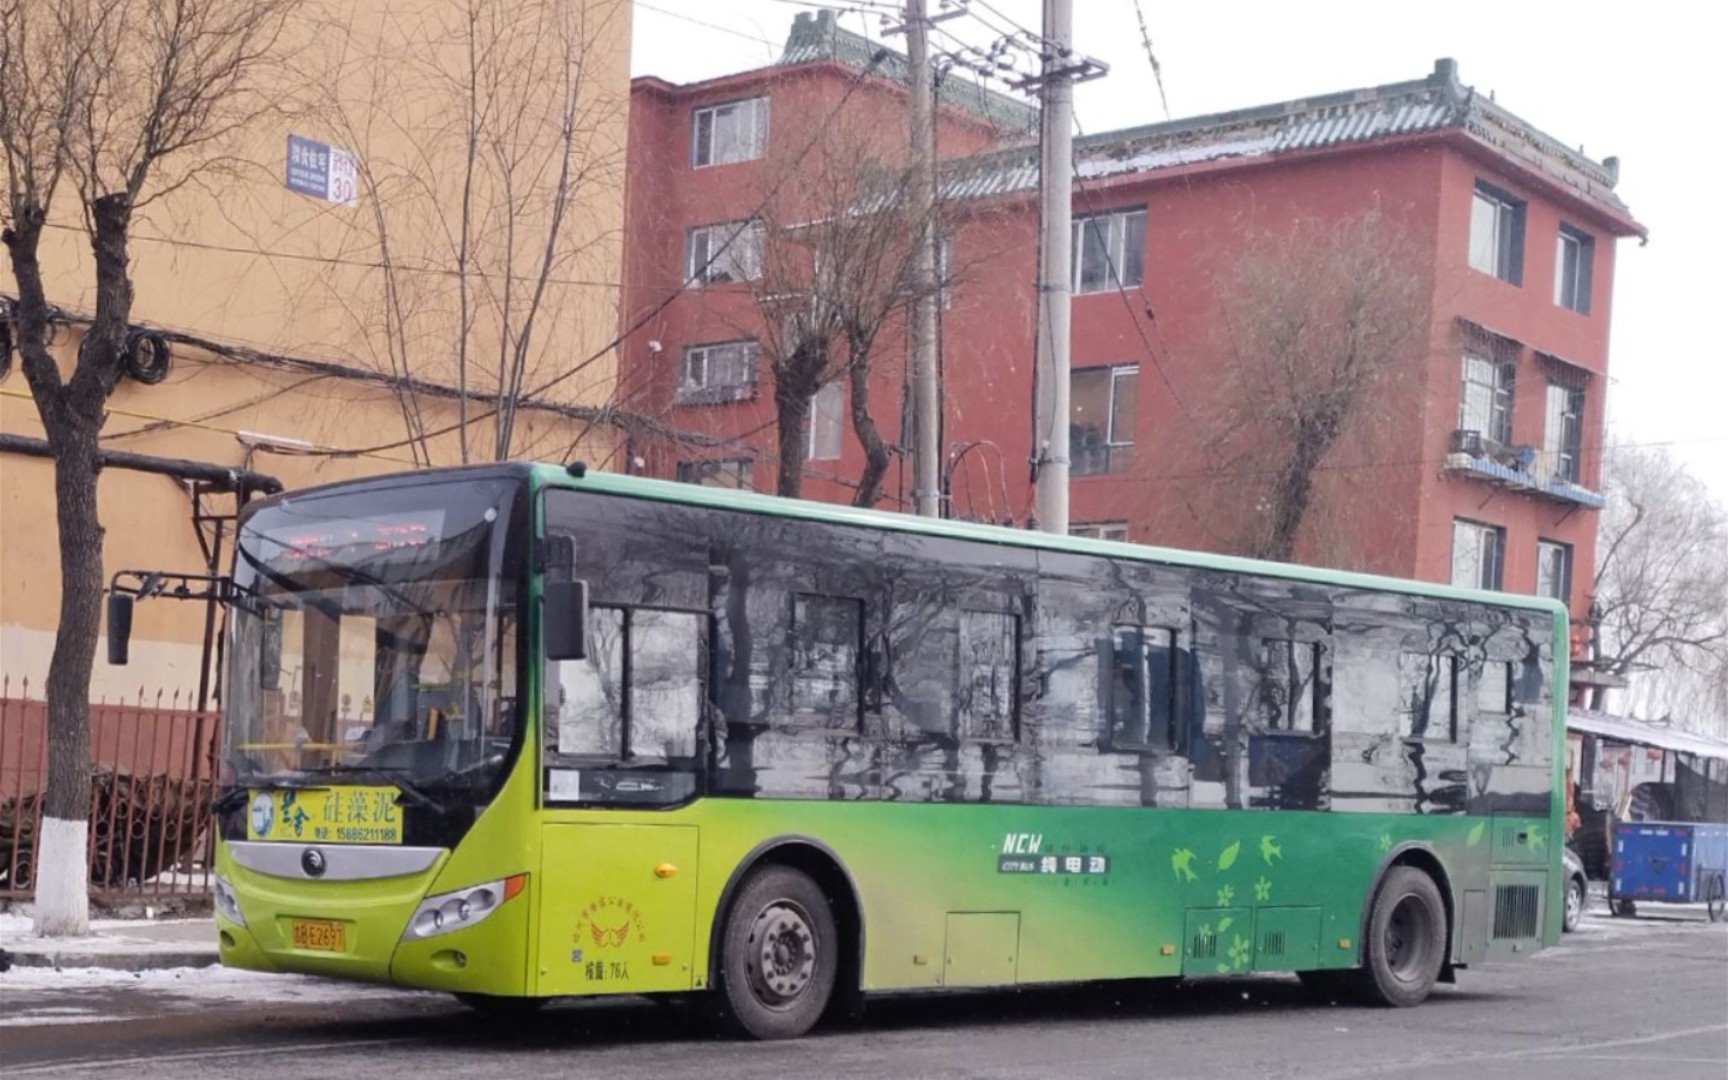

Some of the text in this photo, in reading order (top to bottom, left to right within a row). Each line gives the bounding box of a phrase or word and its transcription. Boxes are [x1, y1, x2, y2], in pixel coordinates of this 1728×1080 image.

[333, 177, 351, 202] 30
[323, 791, 397, 824] 硅藻泥
[1041, 856, 1106, 873] 纯电动
